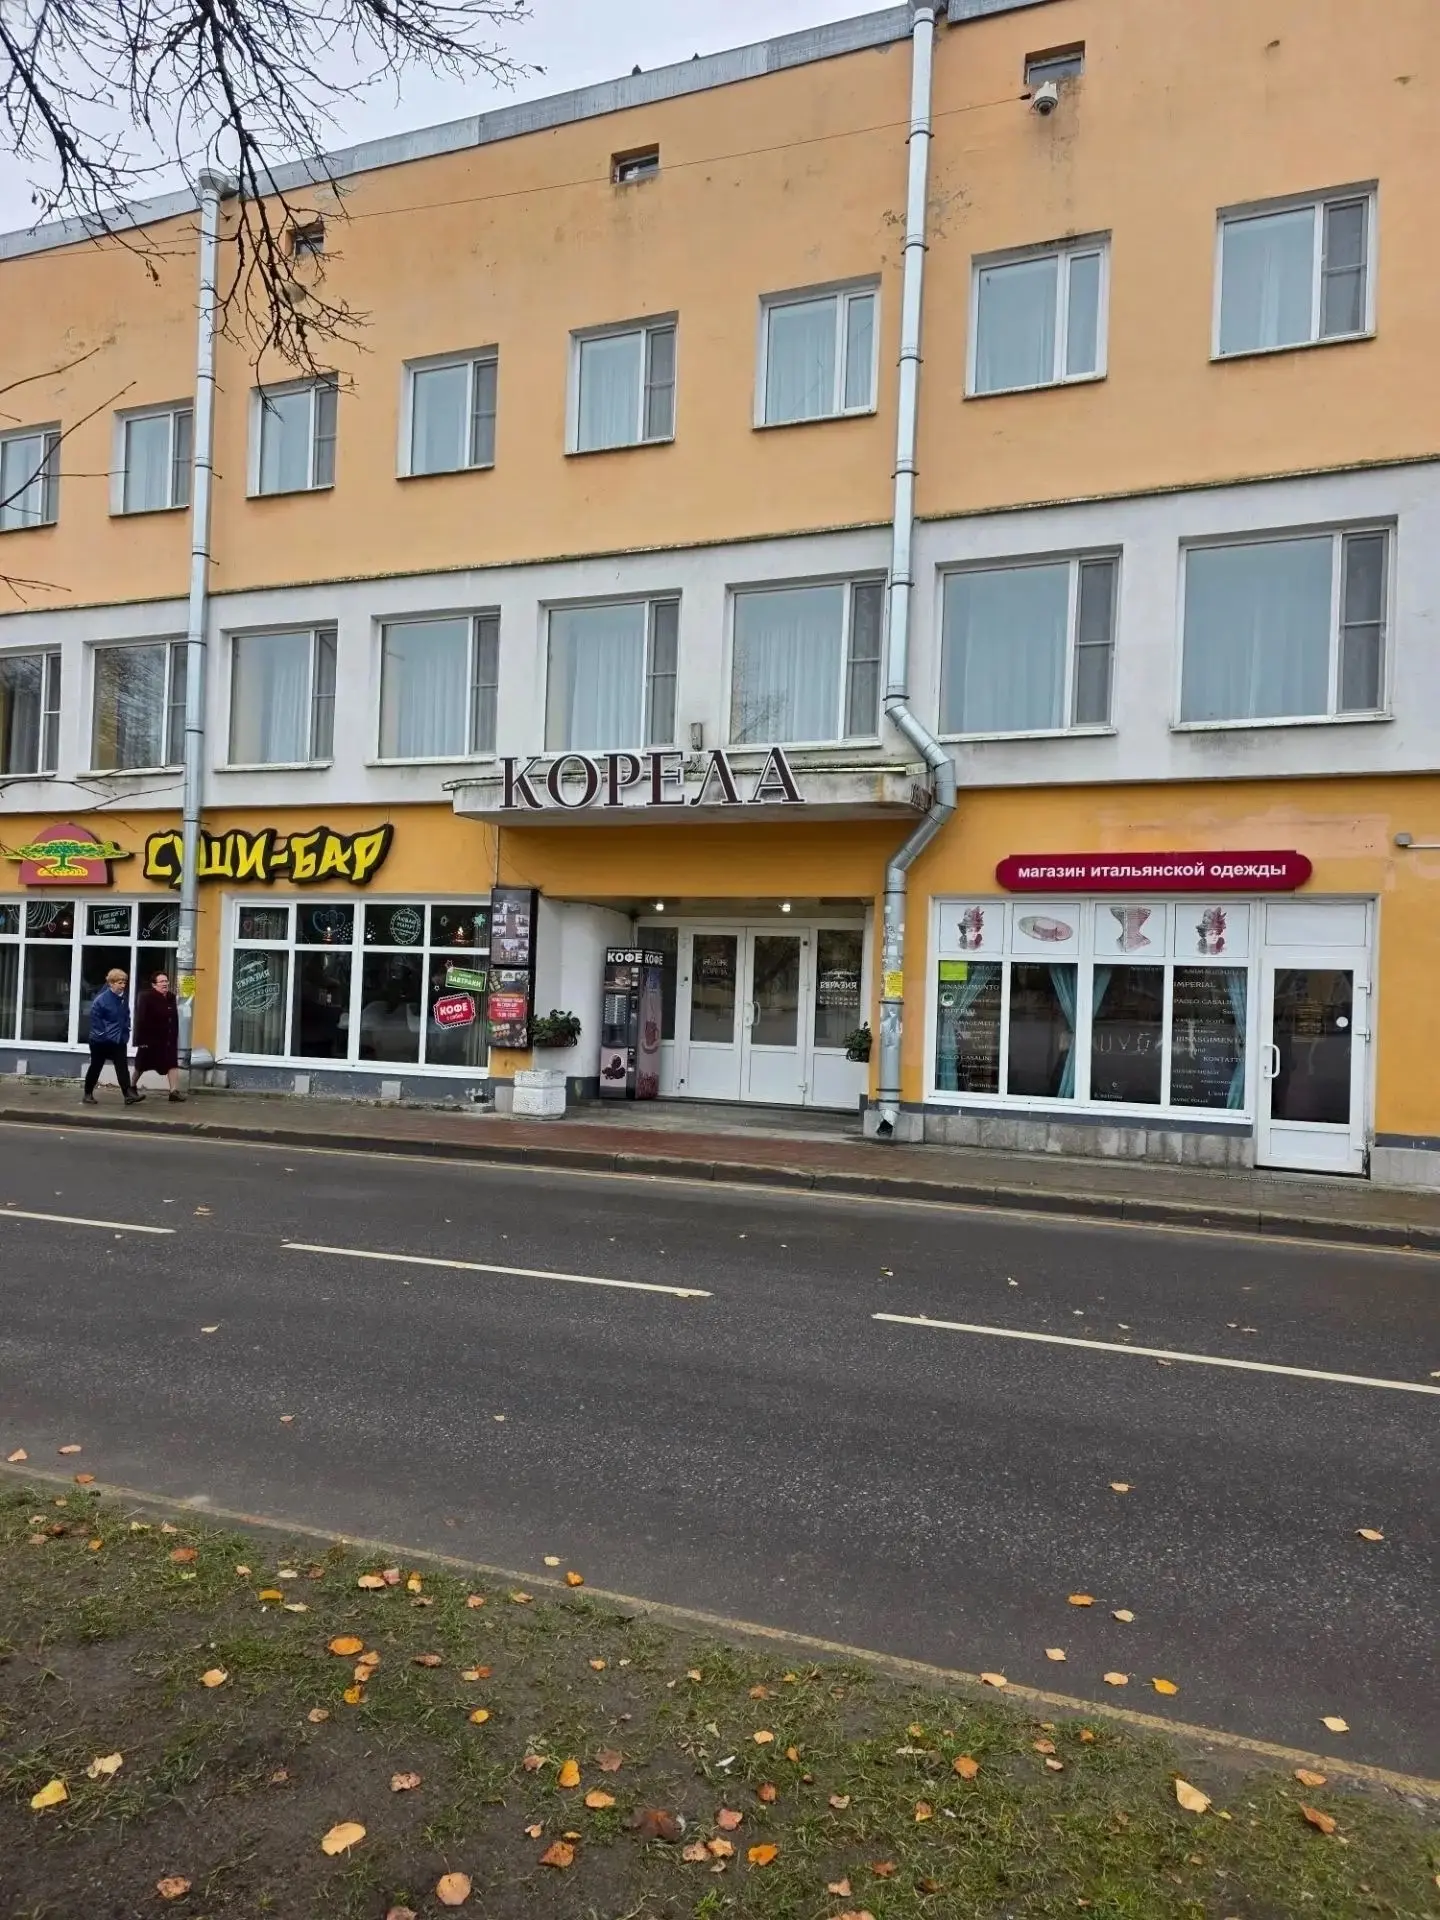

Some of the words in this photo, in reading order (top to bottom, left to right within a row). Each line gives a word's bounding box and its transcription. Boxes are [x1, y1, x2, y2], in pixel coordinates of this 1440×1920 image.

[499, 746, 806, 809] КОРЕЛА
[1018, 865, 1086, 879] магазин
[1090, 862, 1205, 878] итальянской
[1210, 863, 1287, 878] одежды
[607, 952, 643, 963] КОФЕ
[644, 953, 664, 966] КОФЕ
[448, 975, 482, 987] ЗАВТРАКИ
[439, 1002, 469, 1016] КОФЕ
